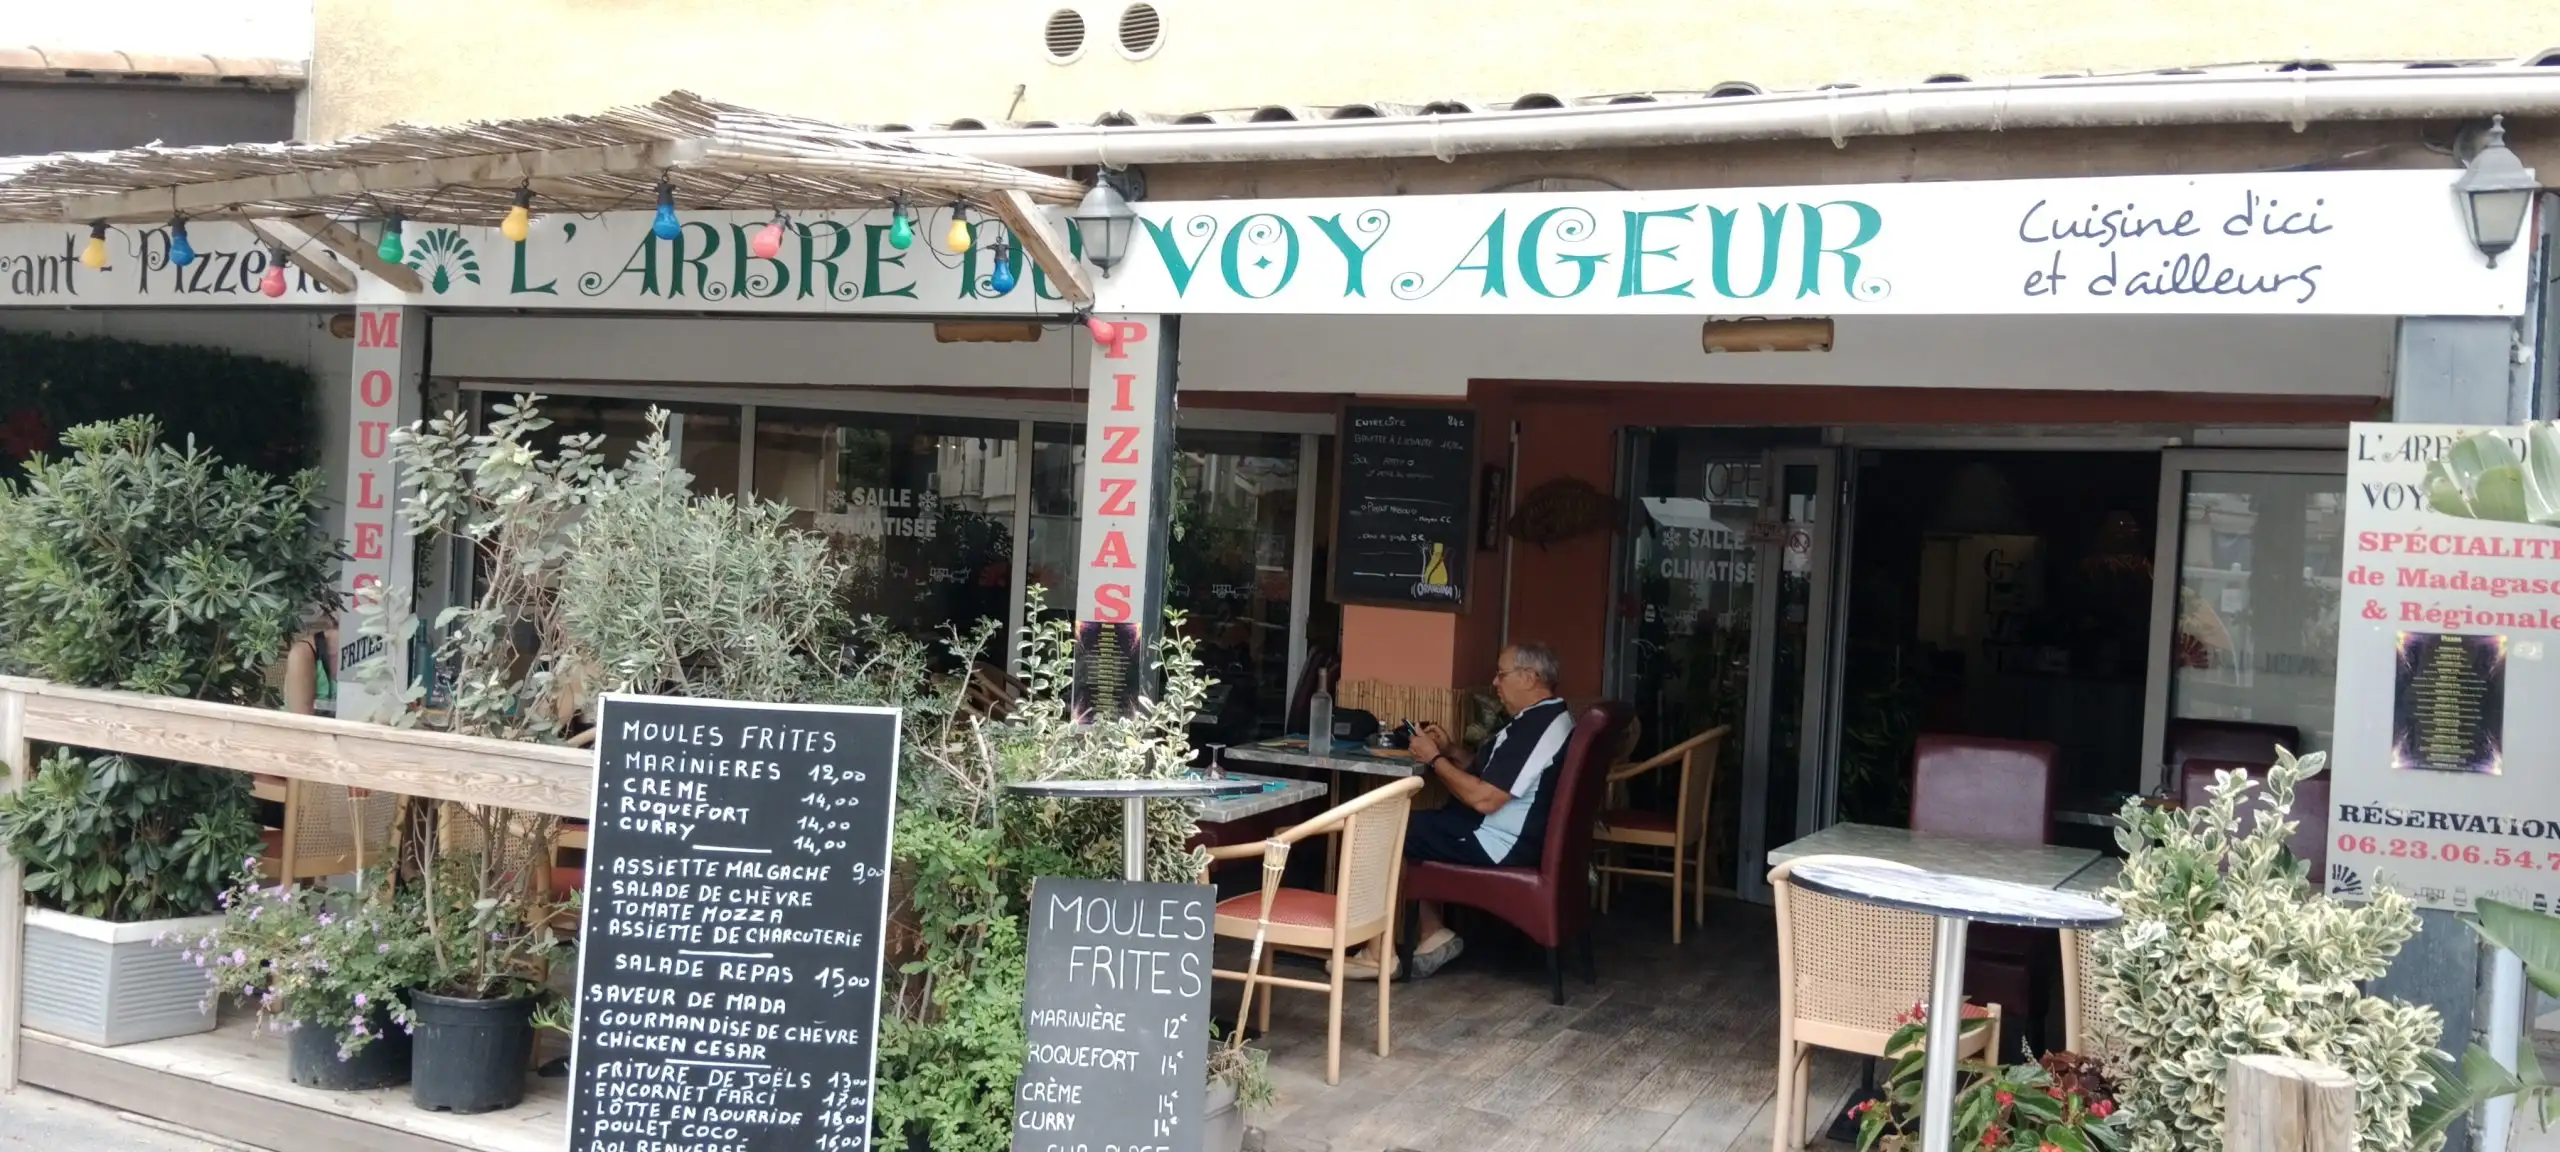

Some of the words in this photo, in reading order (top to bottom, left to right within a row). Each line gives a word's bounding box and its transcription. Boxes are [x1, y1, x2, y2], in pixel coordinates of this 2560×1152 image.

[2018, 199, 2201, 248] Cuisine
[2222, 189, 2334, 237] d'ici
[511, 219, 919, 302] L'ARBRE
[2023, 250, 2066, 297] et
[2358, 432, 2452, 463] L'ARB
[1090, 321, 1148, 623] PIZZAS
[1708, 461, 1761, 498] OPE
[852, 487, 911, 508] SALLE
[1688, 527, 1746, 551] SALLE
[2348, 565, 2385, 587] de
[2361, 599, 2388, 621] &
[340, 634, 383, 671] FRITES
[622, 720, 724, 748] MOULES
[740, 723, 838, 754] FRITES
[625, 750, 781, 780] MARINIERES
[808, 764, 866, 786] 12,00
[623, 777, 709, 802] CREME
[800, 795, 860, 812] 14,00
[620, 796, 750, 825] ROQUEFORT
[796, 815, 851, 836] 14,00
[2339, 800, 2560, 840] RÉSERVATION
[619, 816, 696, 841] CURRY
[793, 836, 847, 856] 14,00
[2337, 833, 2560, 871] 06.23.06.54.7
[612, 855, 720, 878] ASSIETTE
[725, 860, 832, 882] MALGACHE
[612, 880, 690, 900] SALADE
[698, 884, 723, 903] DE
[612, 899, 695, 922] TOMATE
[702, 905, 783, 925] MOZZA
[1049, 893, 1206, 941] MOULES
[608, 918, 702, 944] ASSIETTE
[713, 924, 741, 945] DE
[746, 925, 862, 947] CHARCUTERIE
[615, 952, 704, 978] SALADE
[719, 961, 795, 984] REPAS
[1069, 945, 1202, 998] FRITES
[590, 983, 676, 1006] SAVEUR
[687, 991, 716, 1009] DE
[726, 994, 786, 1015] MADA
[599, 1009, 752, 1038] GOURMANDISE
[757, 1024, 778, 1041] DE
[1030, 1003, 1127, 1033] MARINIÈRE
[596, 1030, 687, 1054] CHICKEN
[694, 1040, 767, 1061] CESAR
[1028, 1043, 1140, 1072] ROQUEFORT
[596, 1057, 690, 1086] FRITURE
[708, 1069, 737, 1088] DE
[594, 1081, 709, 1103] ENCORNET
[715, 1088, 776, 1107] FARCI
[1022, 1076, 1083, 1104] CRÈME
[594, 1118, 672, 1141] POULET
[681, 1123, 739, 1141] COCO
[671, 1104, 697, 1122] EN
[703, 1106, 803, 1126] BOURRIDE
[1018, 1110, 1076, 1132] CURRY
